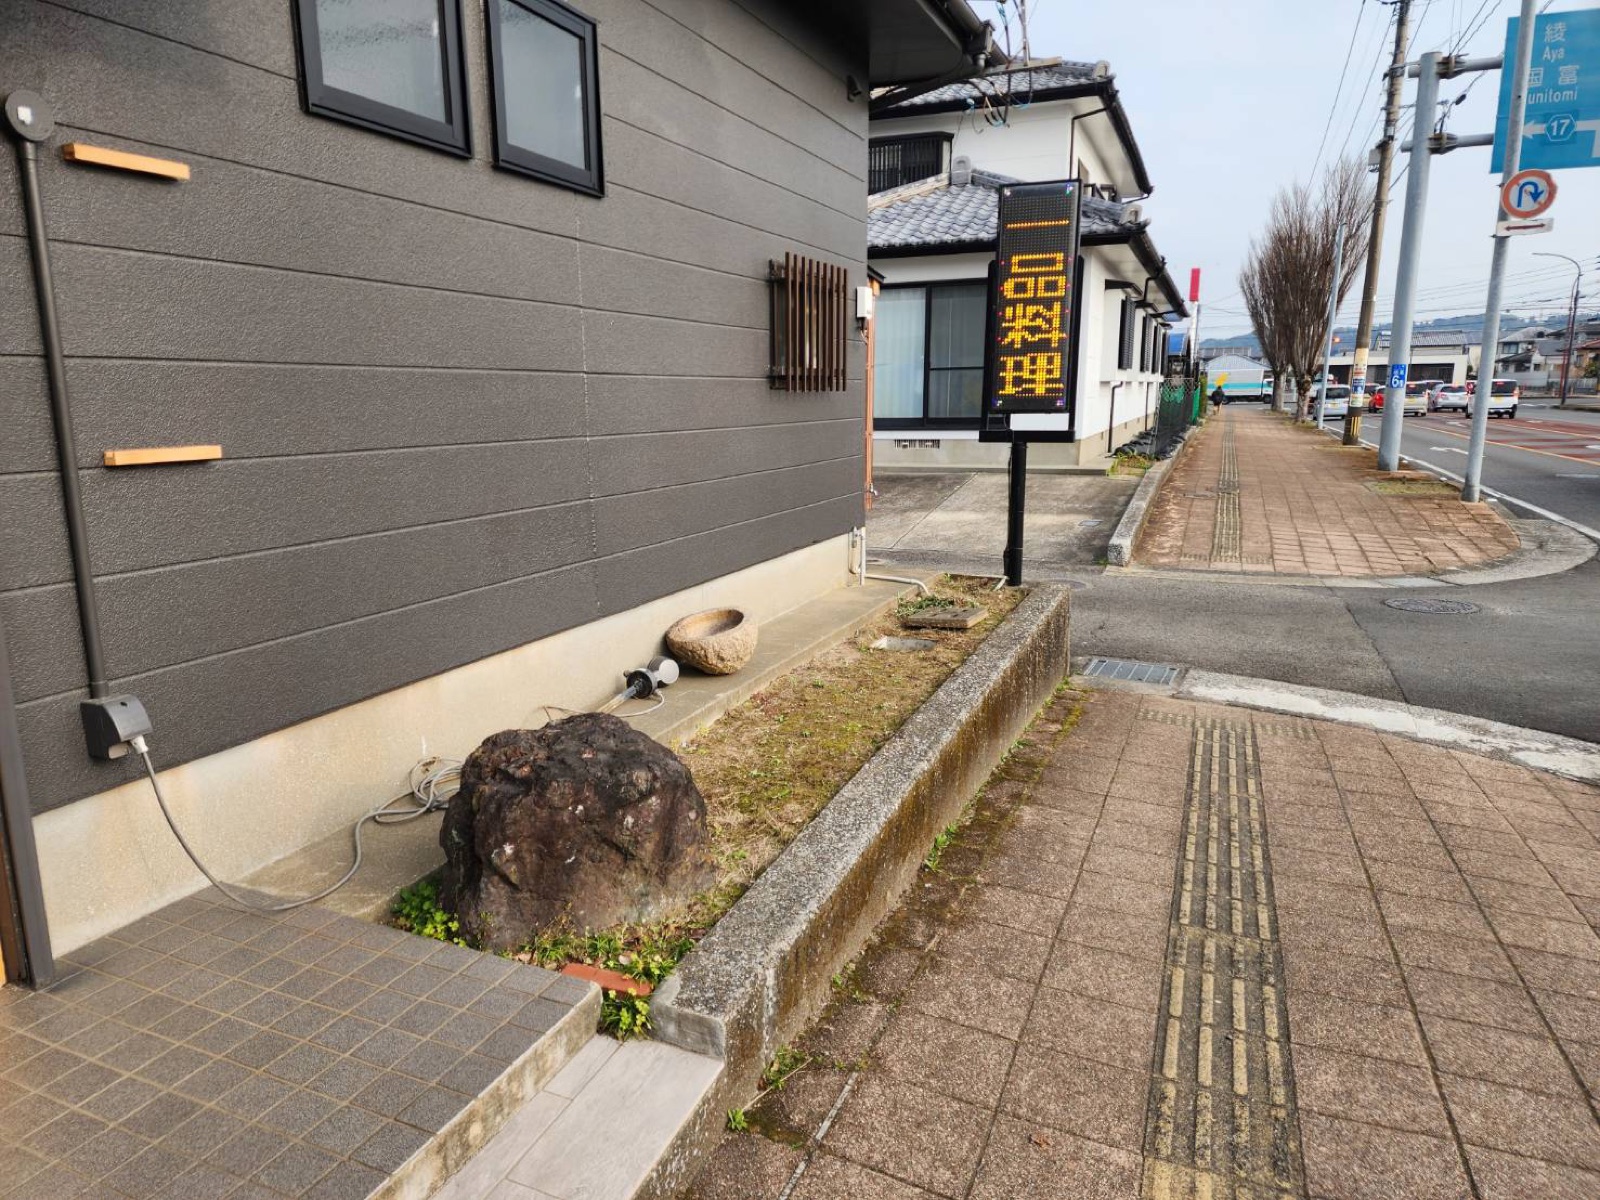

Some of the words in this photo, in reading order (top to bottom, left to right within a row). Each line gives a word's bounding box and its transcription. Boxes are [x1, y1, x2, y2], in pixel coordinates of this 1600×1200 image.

[1544, 22, 1567, 43] 綾
[1543, 46, 1565, 63] Aya
[1526, 86, 1578, 105] unitomi
[1550, 119, 1570, 136] 17
[999, 219, 1070, 396] 一品料理
